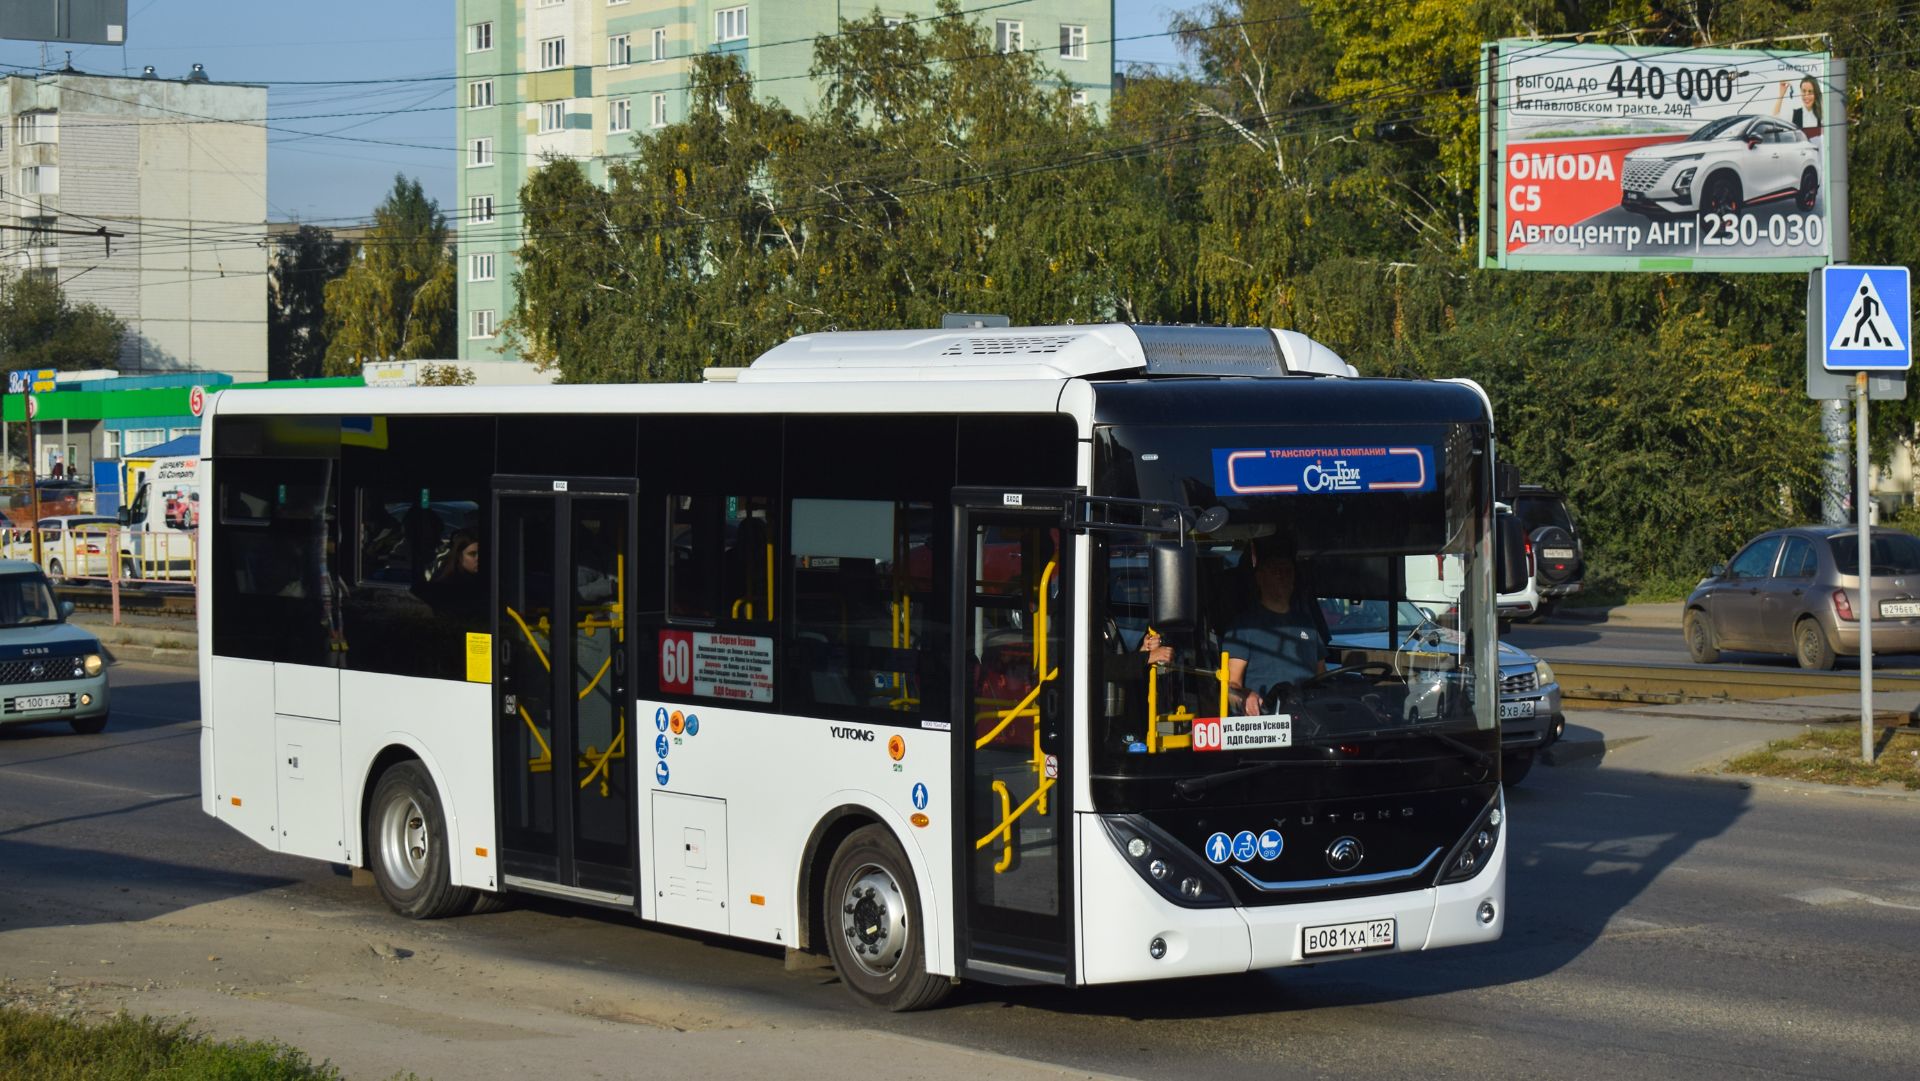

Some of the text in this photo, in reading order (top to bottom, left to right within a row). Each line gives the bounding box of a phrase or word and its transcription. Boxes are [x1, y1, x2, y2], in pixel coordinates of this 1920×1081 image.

[1516, 65, 1732, 102] ВЫГОДА ДО 440 000
[1535, 101, 1613, 112] Павловском
[1617, 104, 1660, 116] тракте,
[1664, 104, 1692, 117] 249Д
[1509, 153, 1615, 181] OMODA
[1509, 185, 1541, 212] C5
[1509, 213, 1823, 250] Автоцентр АНТ 230-030
[1270, 448, 1386, 458] ТРАНСПОРТНАЯ КОМПАНИЯ
[663, 638, 689, 684] 60
[830, 726, 875, 742] YUTONG
[1194, 723, 1220, 747] 60
[1223, 720, 1290, 733] ул. Сергея Ускова
[1227, 735, 1243, 746] ЛДП
[1245, 734, 1277, 745] Спартак
[1282, 733, 1287, 742] 2
[1310, 923, 1390, 949] В081ХА 122
